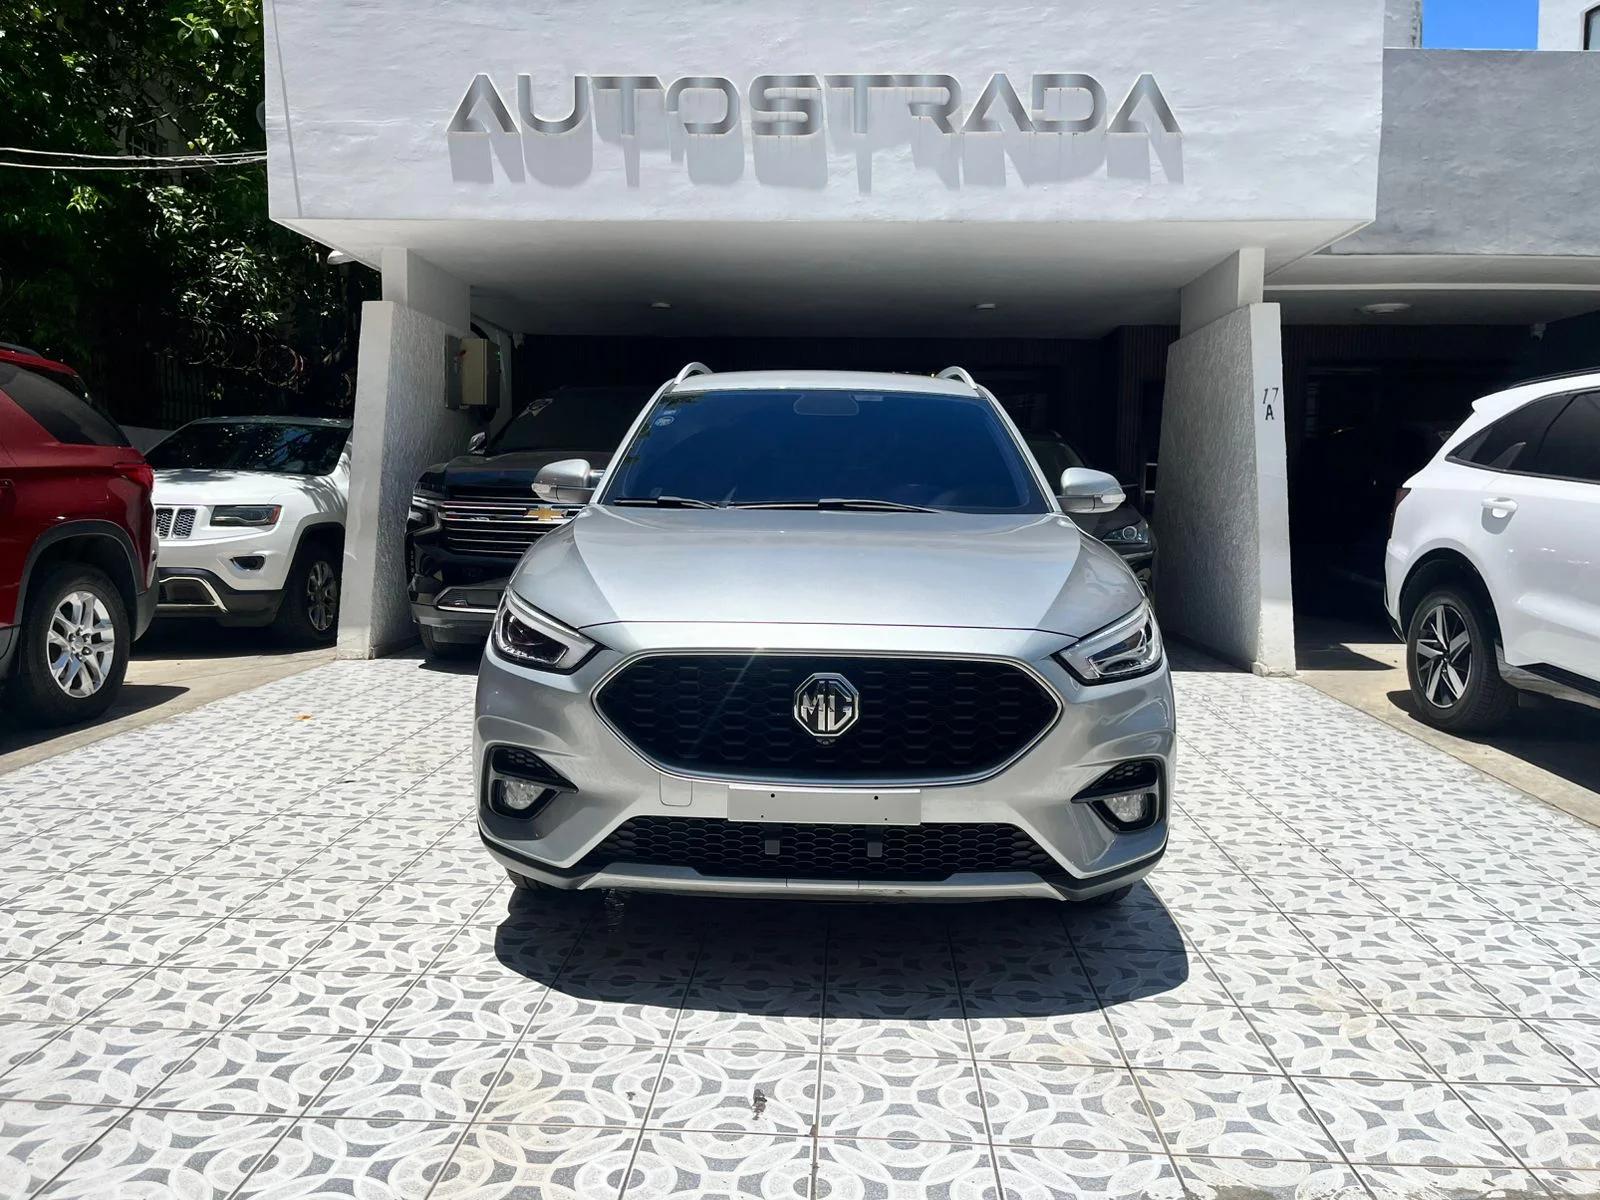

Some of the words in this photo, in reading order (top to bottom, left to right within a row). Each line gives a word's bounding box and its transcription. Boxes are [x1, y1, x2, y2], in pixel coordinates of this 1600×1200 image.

[446, 72, 1183, 136] AUTOSTRADA
[1262, 387, 1279, 404] 17
[1265, 404, 1274, 420] A
[800, 680, 853, 732] MG
